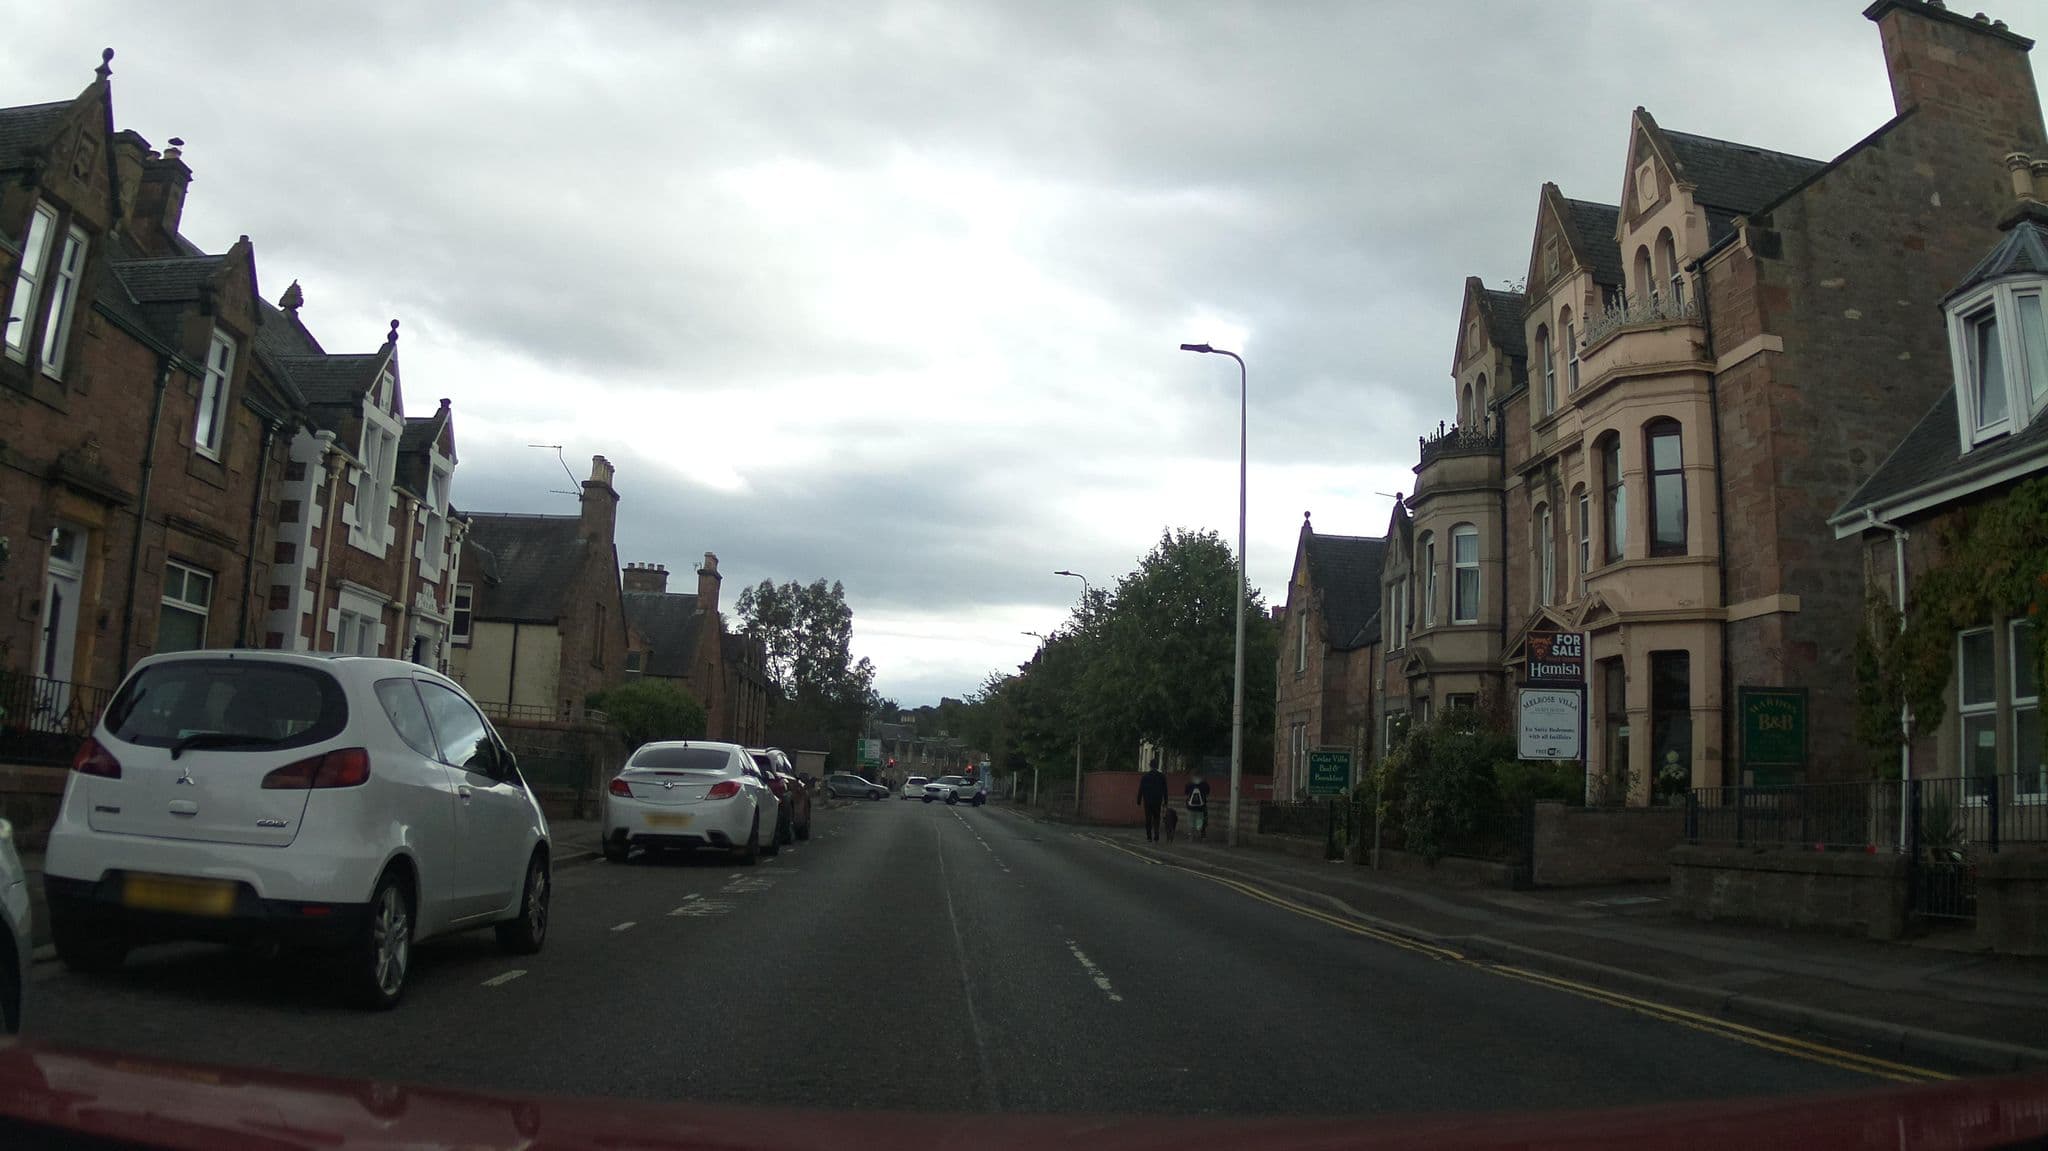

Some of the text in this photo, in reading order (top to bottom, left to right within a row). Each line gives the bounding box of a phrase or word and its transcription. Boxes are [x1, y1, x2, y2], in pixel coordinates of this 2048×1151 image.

[1556, 634, 1581, 646] FOR
[1552, 645, 1581, 657] SALE
[1530, 662, 1581, 678] Hamish
[1523, 696, 1556, 709] MELROSE
[1558, 696, 1578, 711] VILLA
[1759, 713, 1793, 730] B&B
[256, 818, 289, 828] COLT
